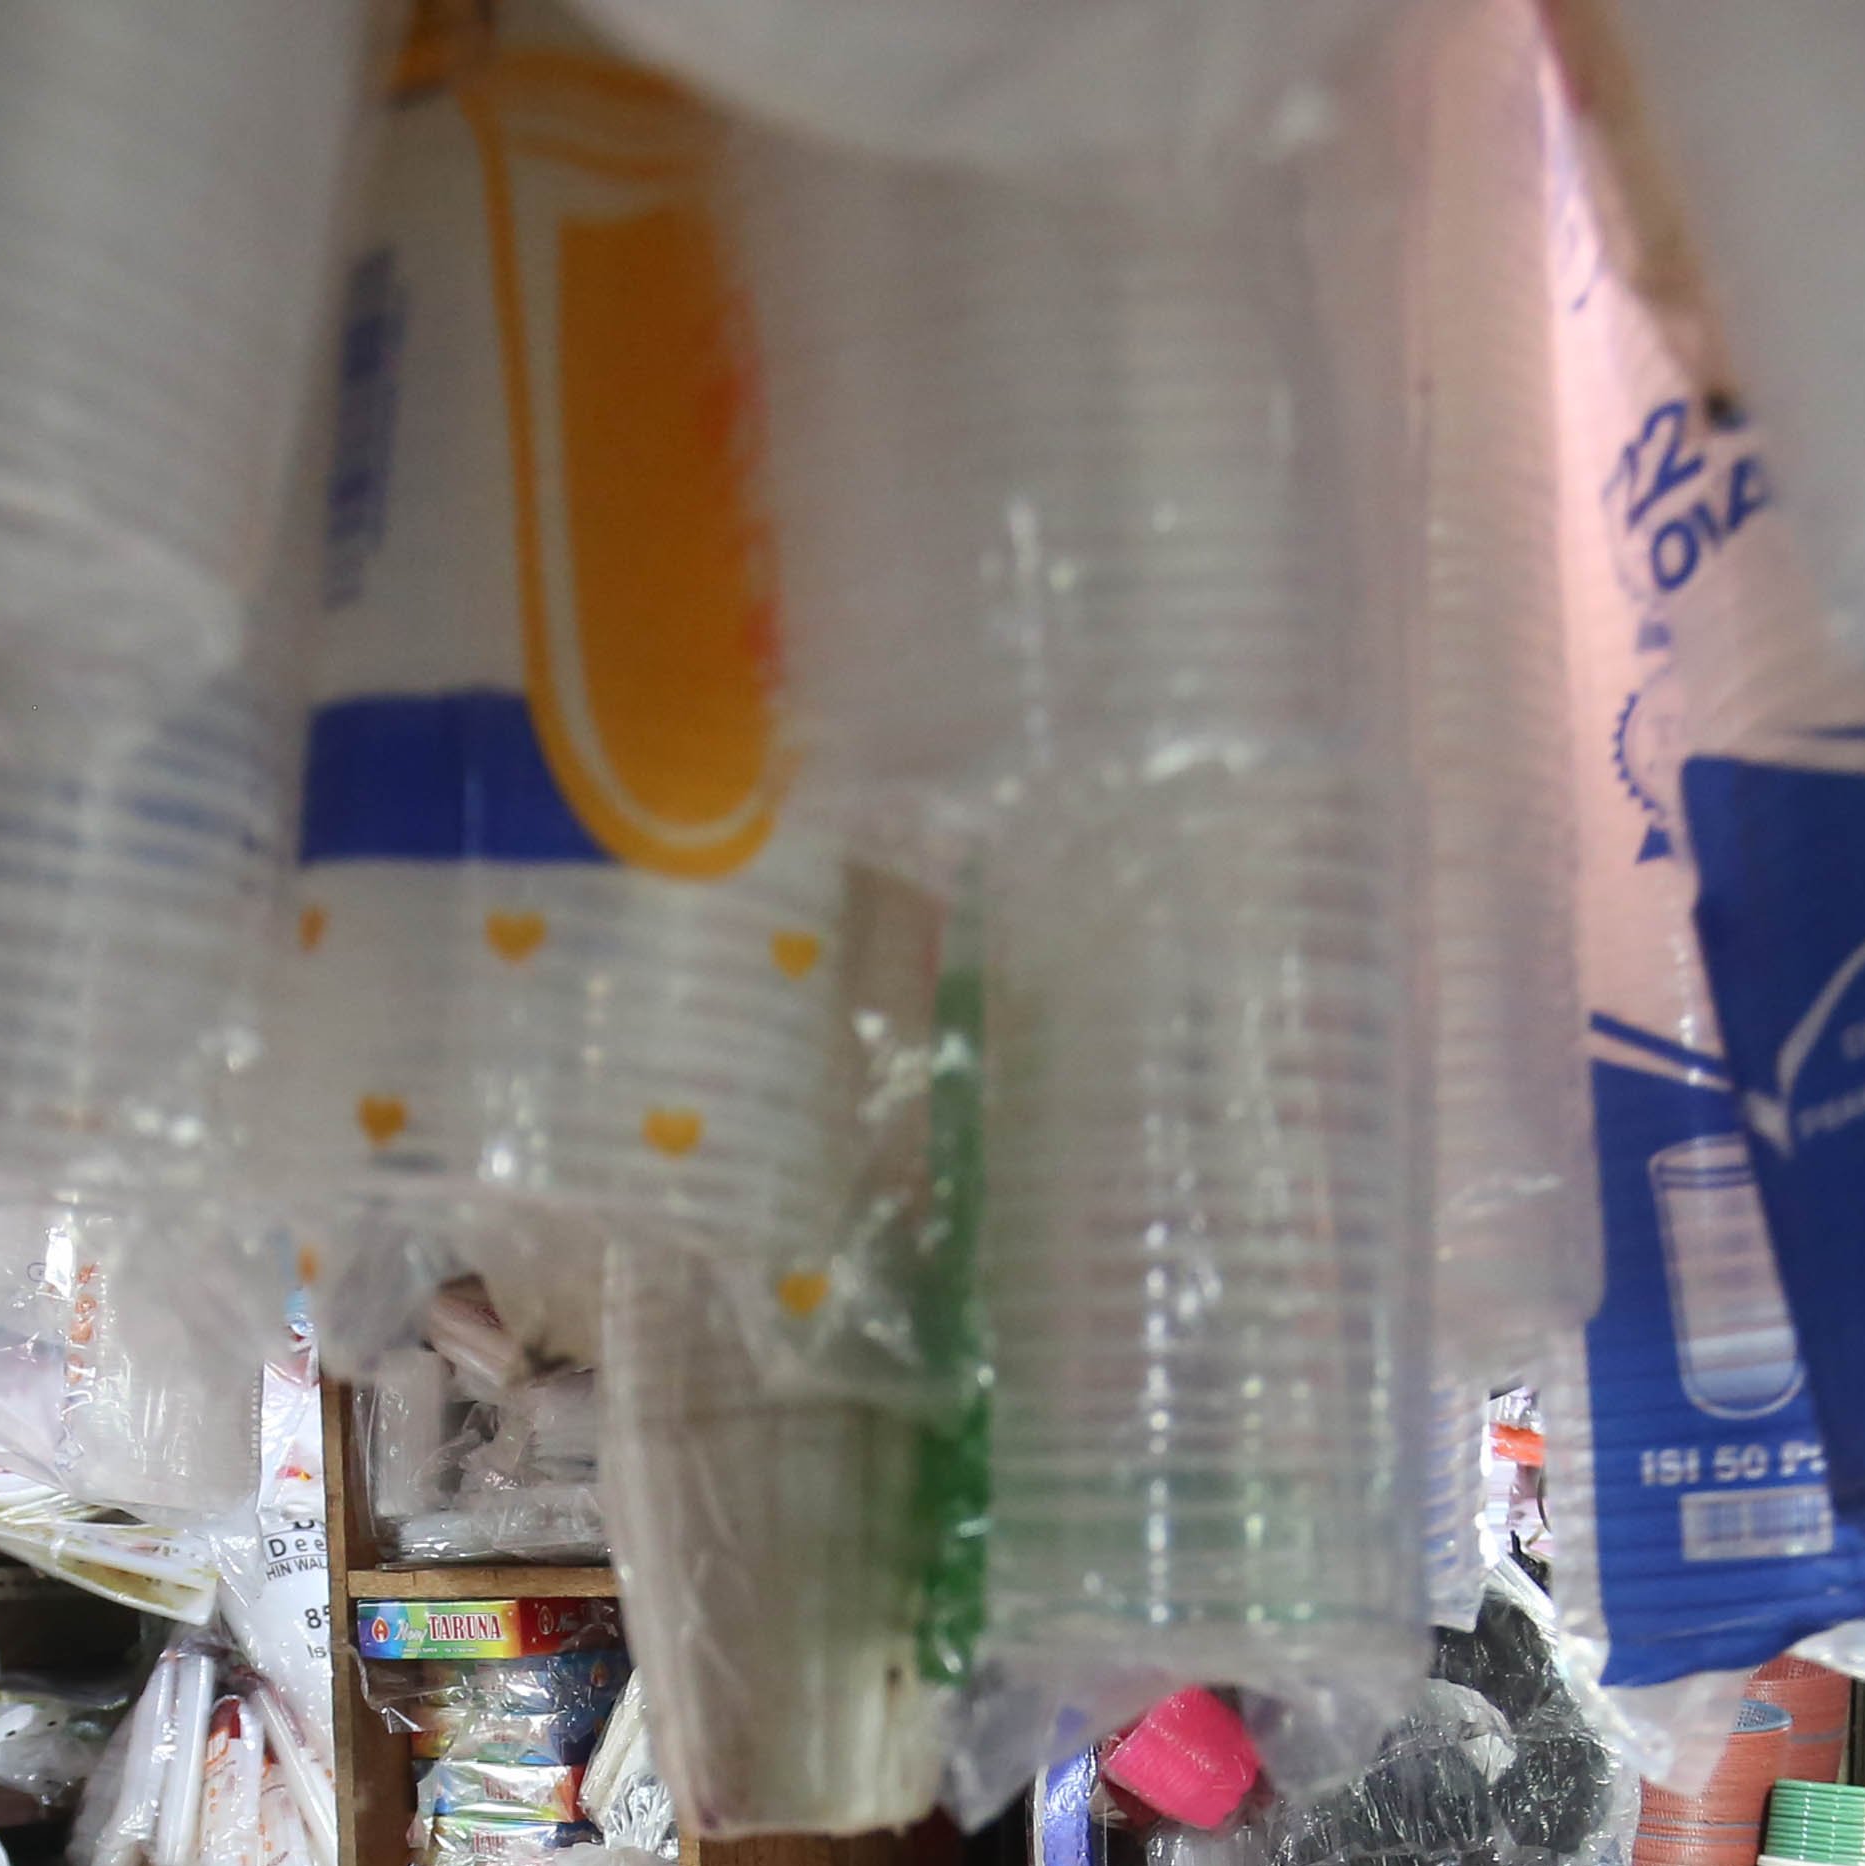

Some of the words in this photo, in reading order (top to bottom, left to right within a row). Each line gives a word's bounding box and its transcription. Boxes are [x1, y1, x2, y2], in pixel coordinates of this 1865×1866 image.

[1712, 1445, 1767, 1478] 50
[266, 1561, 294, 1580] HIN
[294, 1556, 327, 1572] WAL
[428, 1613, 505, 1641] TARUNA
